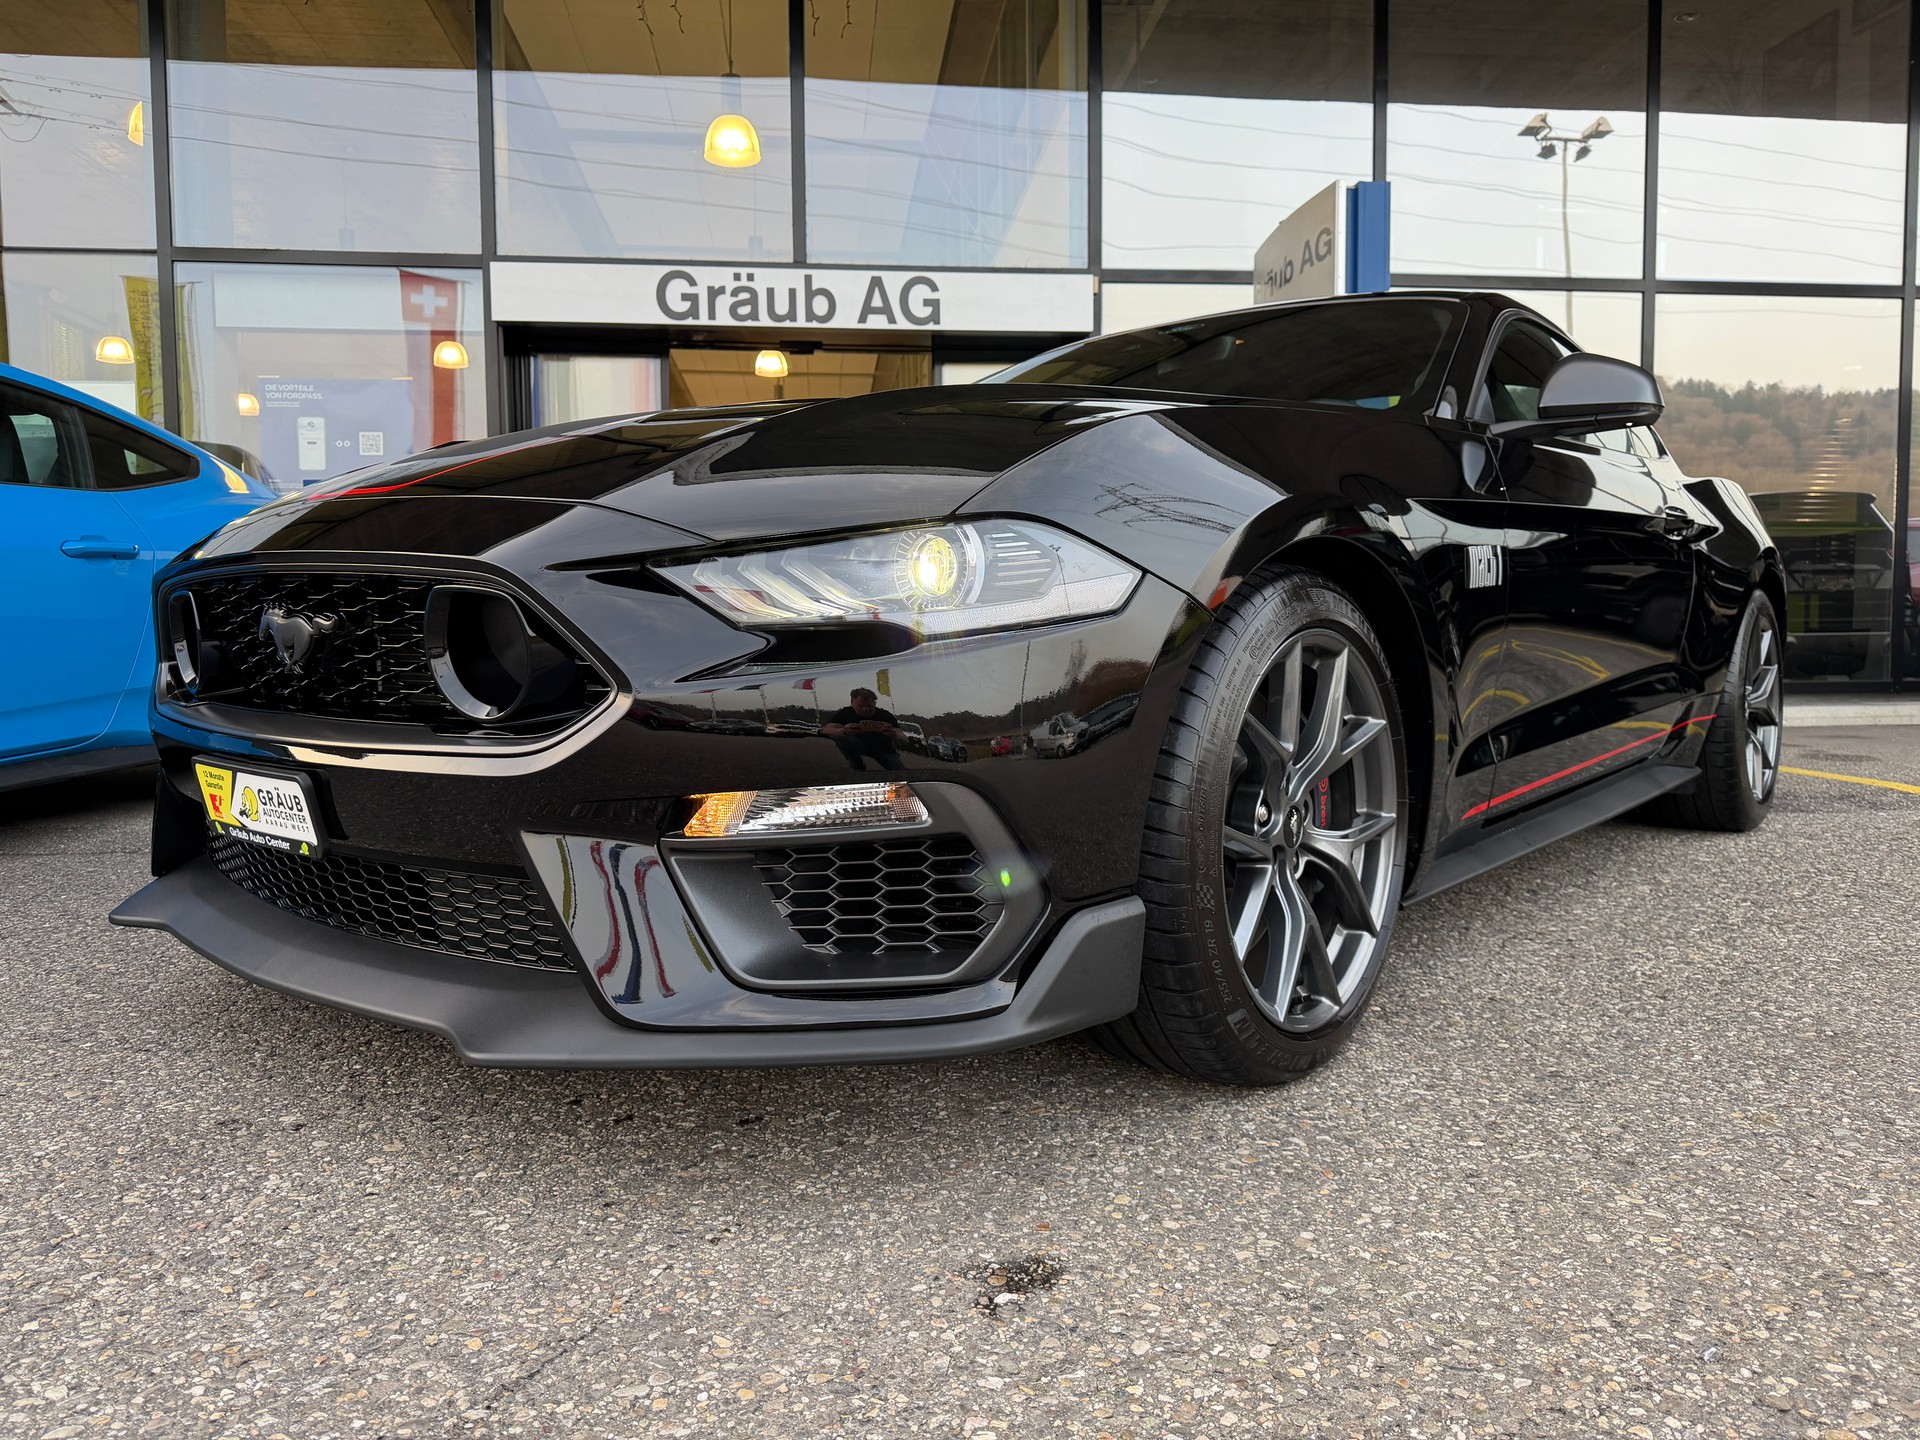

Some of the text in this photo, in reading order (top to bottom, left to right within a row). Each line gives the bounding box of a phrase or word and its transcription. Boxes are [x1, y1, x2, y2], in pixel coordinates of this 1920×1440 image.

[1299, 227, 1332, 275] AG
[656, 270, 941, 326] Gräub AG
[282, 392, 323, 400] FORDPASS
[257, 787, 304, 813] GRÄUB
[1198, 781, 1209, 832] OUTSIDE
[262, 808, 308, 825] AUTOCENTER
[265, 819, 310, 834] AARAU WEST
[229, 826, 290, 850] Gräub Auto Center
[1203, 919, 1234, 1004] 255/40 ZR 19
